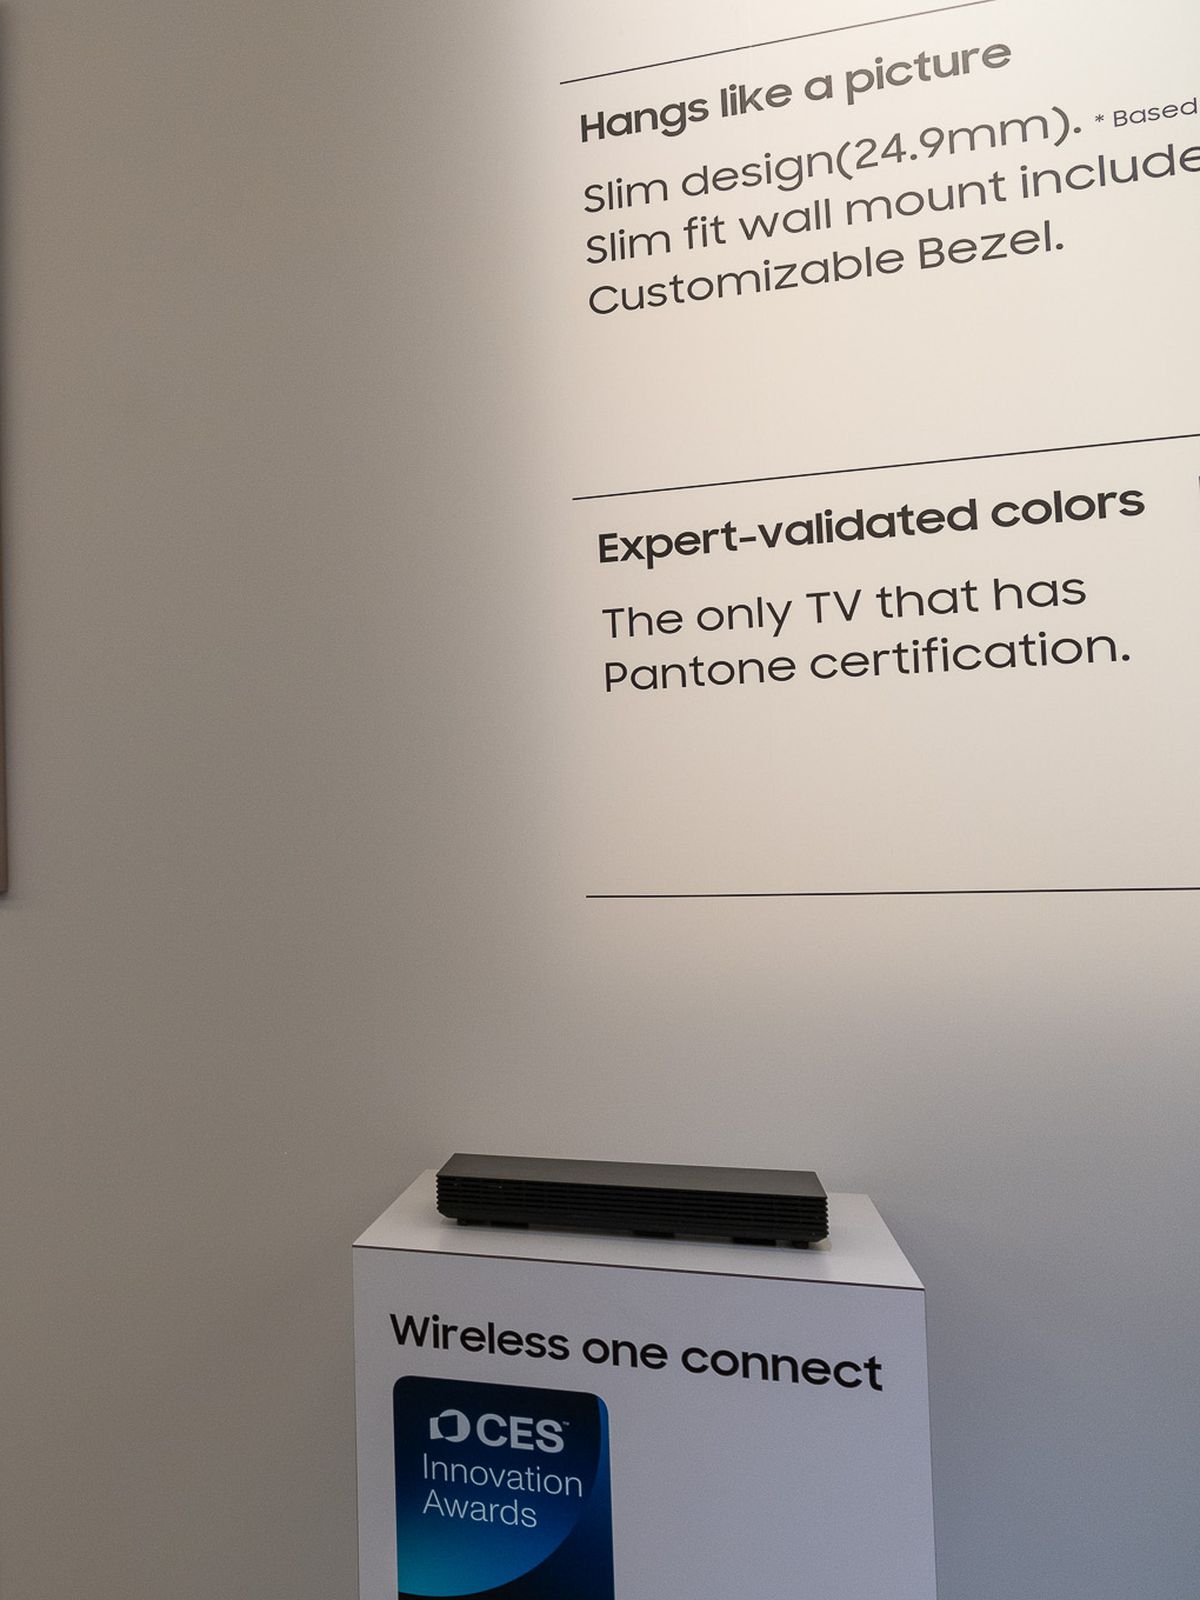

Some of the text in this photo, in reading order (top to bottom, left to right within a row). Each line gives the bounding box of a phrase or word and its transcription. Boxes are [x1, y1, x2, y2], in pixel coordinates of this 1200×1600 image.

[580, 43, 1012, 144] Hangs like a picture
[583, 177, 669, 214] Slim
[681, 105, 1082, 197] design(24.9mm).
[1112, 97, 1198, 128] Based
[586, 228, 672, 265] Slim
[682, 214, 727, 250] fit
[737, 198, 832, 241] wall
[845, 170, 1008, 226] mount
[588, 220, 1065, 315] Customizable Bezel.
[598, 489, 1146, 571] Expert-validated colors
[601, 577, 1087, 639] The only TV that has
[604, 630, 1131, 693] Pantone certification.
[388, 1313, 884, 1392] Wireless one connect
[422, 1488, 538, 1529] Awards
[423, 1452, 583, 1498] Innovation
